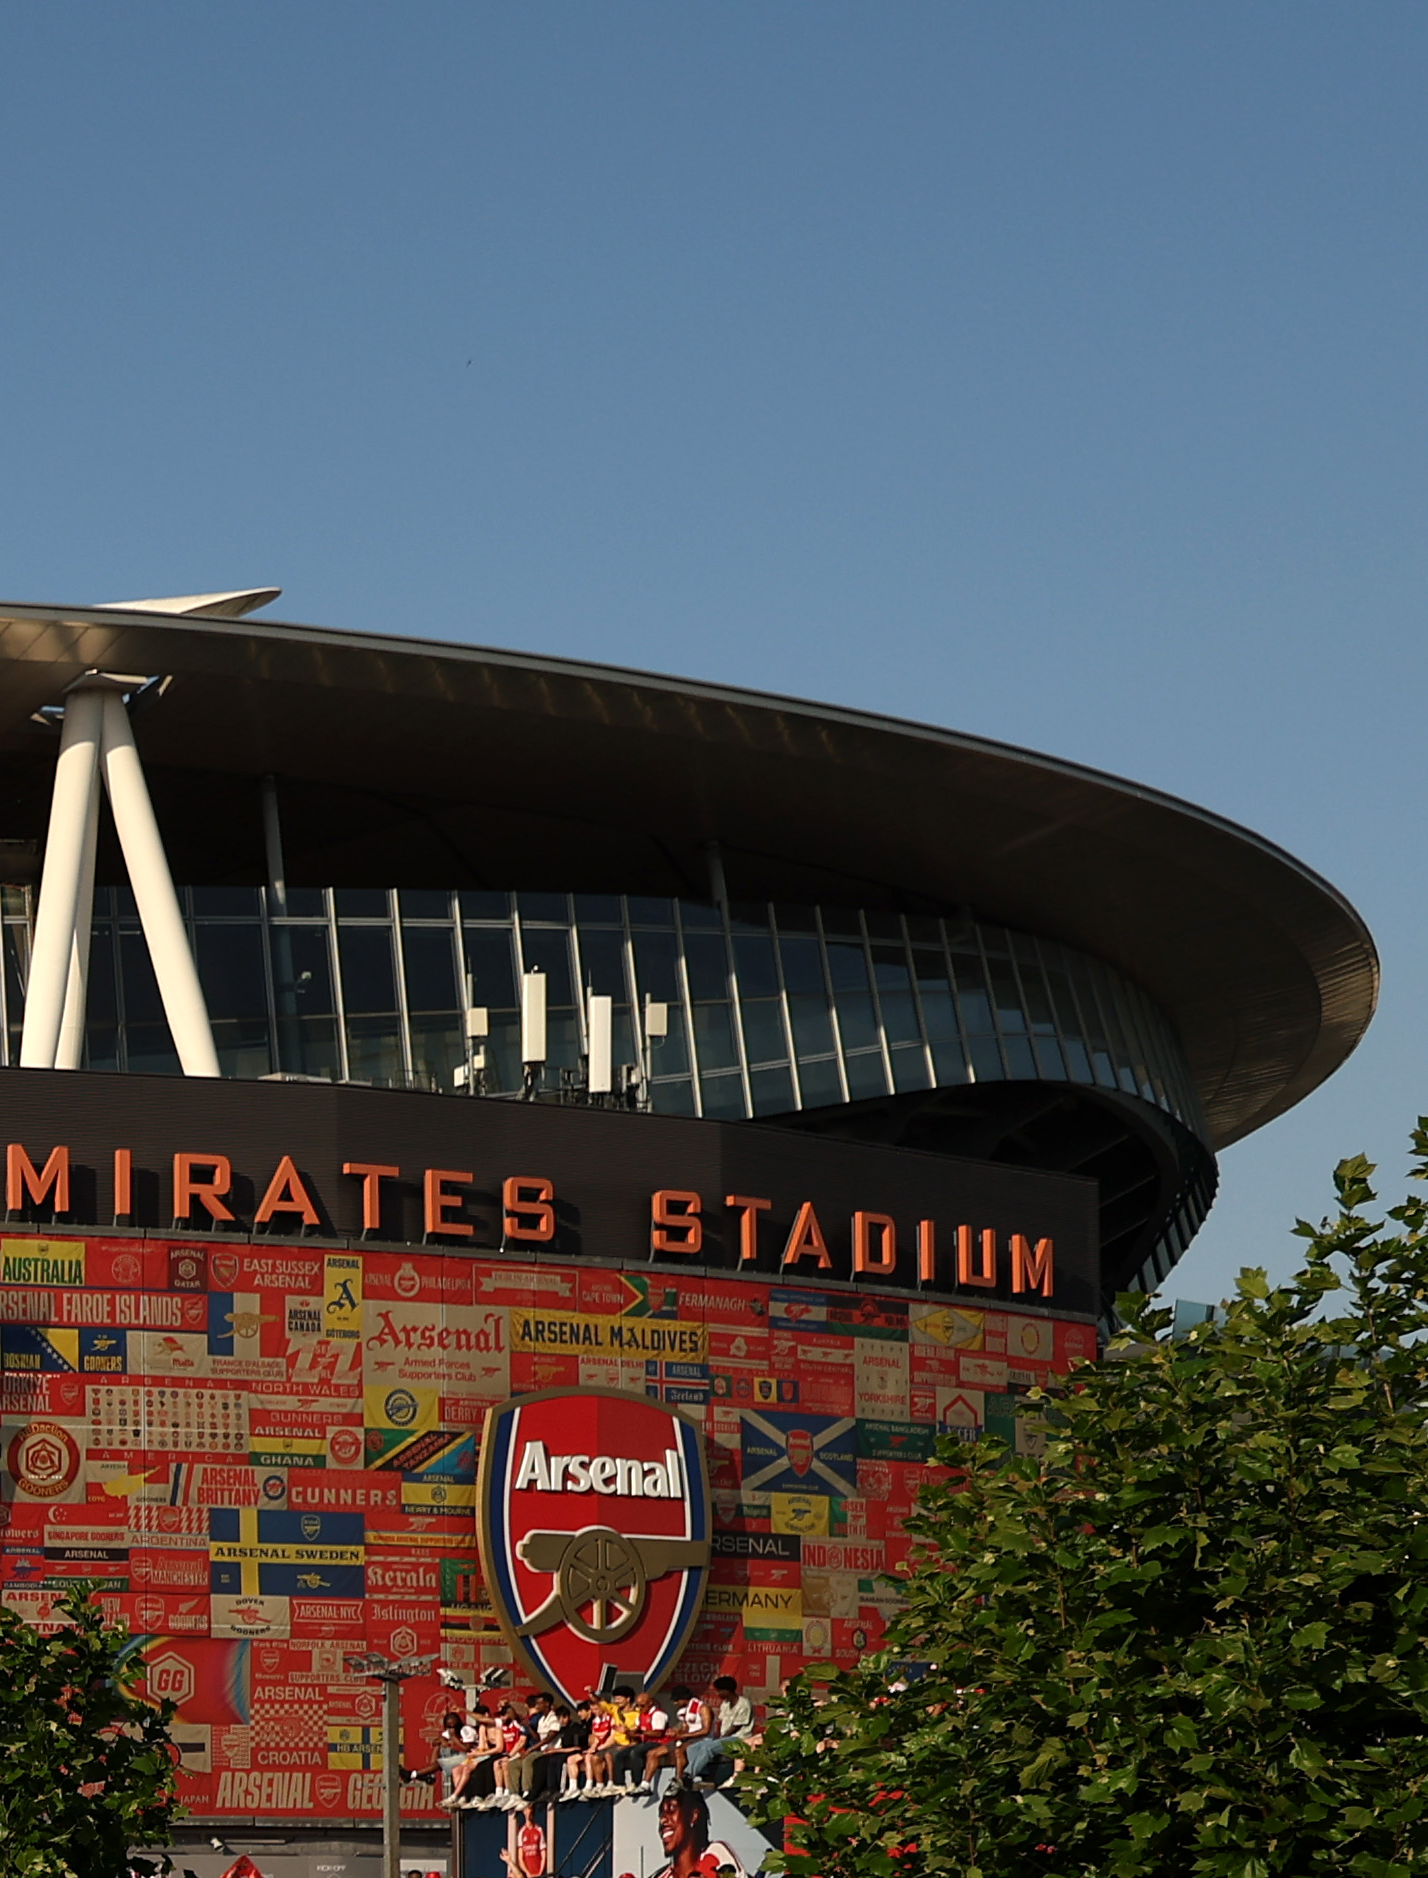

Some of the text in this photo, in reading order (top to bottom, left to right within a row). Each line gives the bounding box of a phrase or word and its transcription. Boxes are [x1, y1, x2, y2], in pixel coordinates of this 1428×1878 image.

[652, 1190, 1054, 1297] STADIUM
[170, 1250, 204, 1261] ARSENAL
[243, 1259, 321, 1275] EAST SUSSEX
[326, 1258, 360, 1269] ARSENAL
[2, 1257, 83, 1285] AUSTRALIA
[174, 1280, 201, 1289] QATAR
[253, 1275, 313, 1289] ARSENAL
[582, 1291, 624, 1304] CAPE TOWN
[679, 1292, 746, 1311] FERMANAGH
[63, 1292, 111, 1323] FAROE
[115, 1295, 182, 1326] ISLANDS
[288, 1309, 322, 1322] ARSENAL
[288, 1321, 322, 1333] CANADA
[326, 1328, 361, 1339] GÖTEBORG
[365, 1310, 506, 1354] Arsenal
[520, 1319, 700, 1353] ARSENAL MALDIVES
[3, 1353, 41, 1369] BOSNIAN
[84, 1356, 123, 1371] GOONERS
[403, 1358, 471, 1370] Armed Forces
[580, 1356, 645, 1369] ARSENAL DELHI
[862, 1356, 901, 1369] ARSENAL
[210, 1368, 284, 1378] SUPPORTERS CLUB
[398, 1370, 477, 1382] Supporters Club
[671, 1365, 702, 1377] ARSENAL
[252, 1382, 359, 1396] NORTH WALES
[858, 1393, 907, 1406] YORKSHIRE
[270, 1412, 343, 1424] GUNNERS
[444, 1407, 477, 1422] DERRY
[255, 1425, 322, 1438] ARSENAL
[747, 1446, 778, 1456] ARSENAL
[819, 1453, 854, 1462] SCOTLAND
[261, 1455, 314, 1466] GHANA
[515, 1440, 682, 1498] Arsenal
[201, 1468, 257, 1487] ARSENAL
[422, 1474, 455, 1483] ARSENAL
[18, 1478, 69, 1497] GOONERS
[197, 1487, 261, 1506] BRITTANY
[291, 1486, 397, 1506] GUNNERS
[0, 1529, 40, 1539] towers
[47, 1530, 126, 1543] SINGAPORE GOONERS
[130, 1535, 207, 1547] ARGENTINA
[712, 1534, 790, 1556] RSENAL
[64, 1550, 109, 1560] ARSENAL
[214, 1546, 360, 1560] ARSENAL SWEDEN
[156, 1556, 204, 1570] Arsenal
[151, 1571, 208, 1586] MANCHESTER
[367, 1566, 437, 1588] Kerala
[235, 1598, 265, 1606] DOVER
[702, 1590, 793, 1609] ERMANY
[371, 1604, 436, 1622] Islington
[169, 1616, 208, 1630] GOONERS
[290, 1641, 325, 1650] NORFOLK
[330, 1642, 366, 1650] ARSENAL
[747, 1643, 799, 1654] LITHUANIA
[675, 1663, 720, 1674] CZECH
[157, 1669, 185, 1692] GG
[290, 1674, 341, 1682] SUPPORTERS
[254, 1687, 324, 1700] ARSENAL
[337, 1744, 351, 1752] HB
[258, 1751, 322, 1765] CROATIA
[217, 1772, 434, 1810] ARSENAL GEOGIA
[180, 1795, 209, 1805] JAPAN
